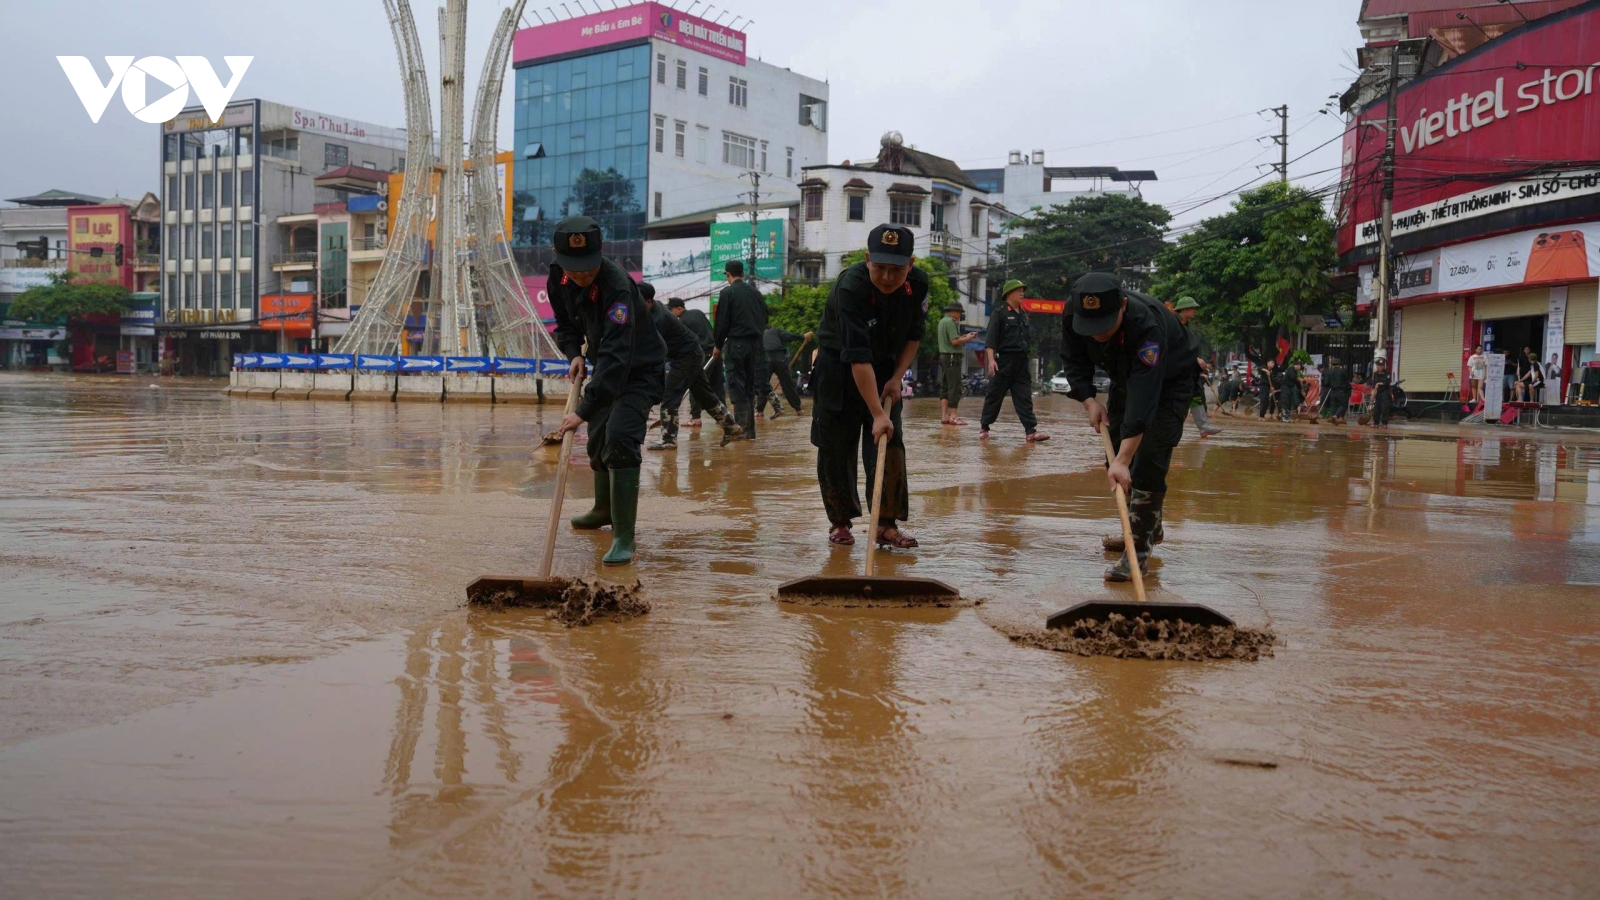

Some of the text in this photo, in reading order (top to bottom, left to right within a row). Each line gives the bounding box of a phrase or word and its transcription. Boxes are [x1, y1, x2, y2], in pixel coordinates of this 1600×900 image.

[618, 20, 630, 28] Em
[1401, 62, 1600, 154] viettel stor
[294, 111, 365, 138] Spa Thu Lan
[1460, 195, 1488, 214] THÔNG
[1488, 190, 1510, 206] MINH
[1518, 184, 1540, 199] SIM
[93, 222, 112, 238] LẠC
[714, 242, 732, 250] CHÚNG
[1450, 265, 1470, 276] 27.490
[180, 309, 236, 323] THU LAN
